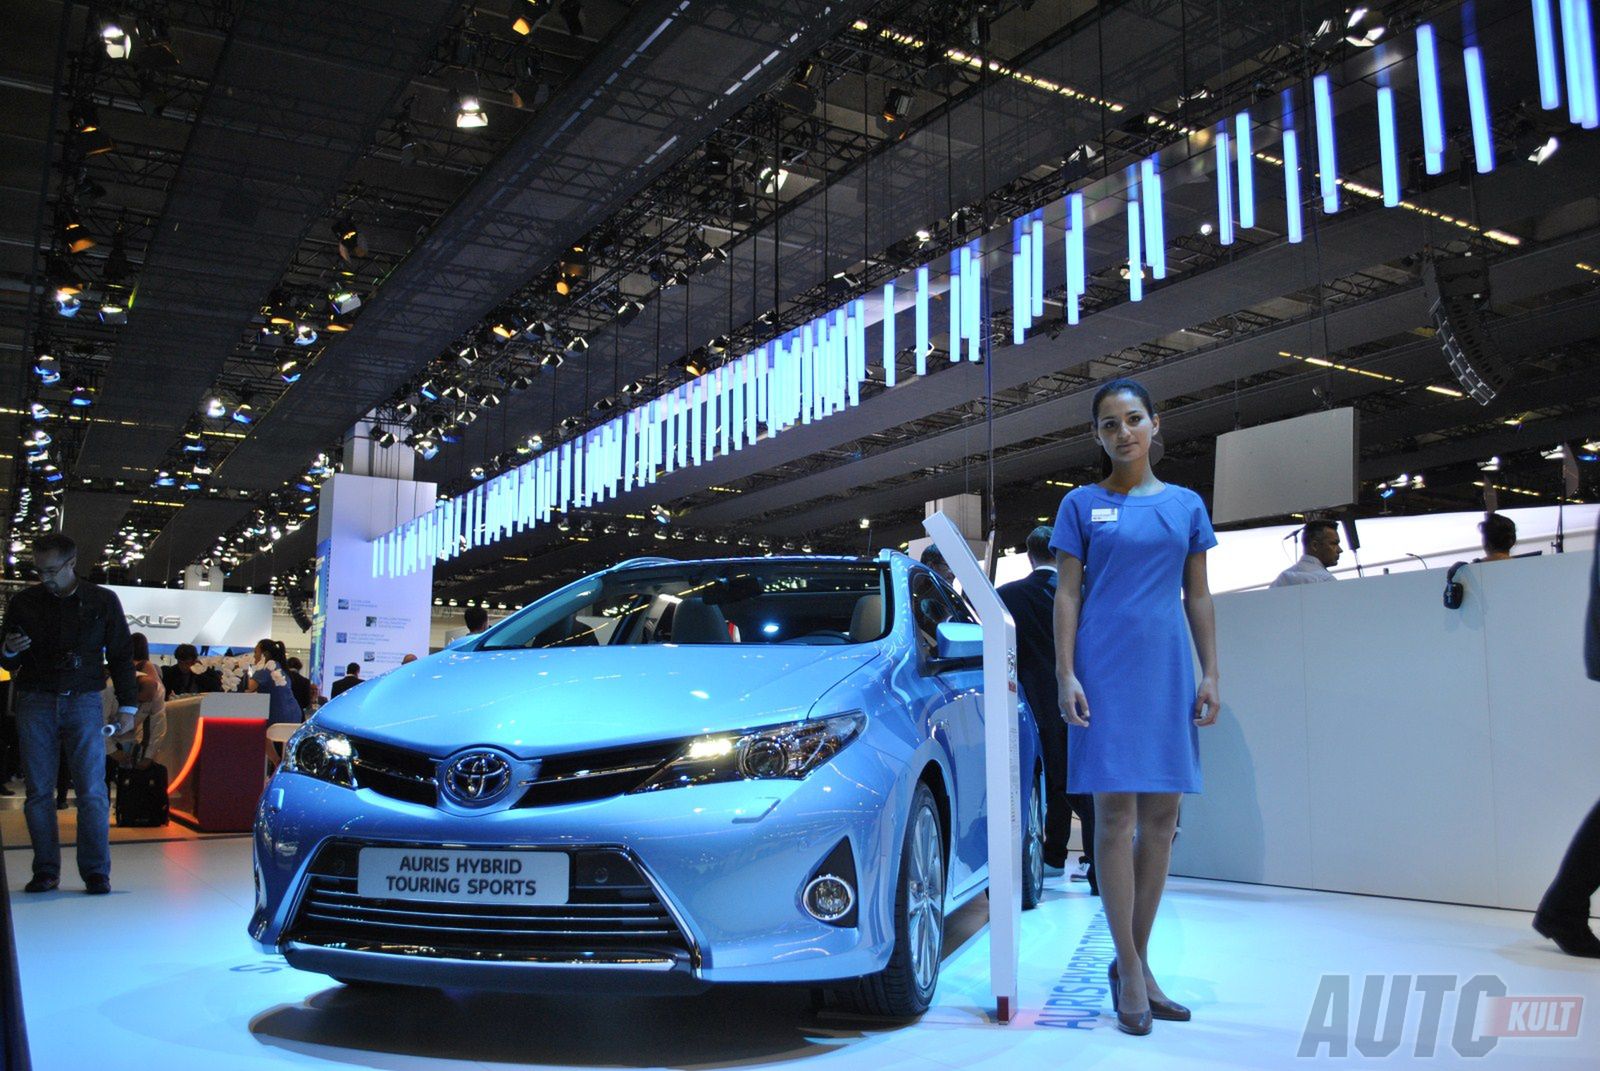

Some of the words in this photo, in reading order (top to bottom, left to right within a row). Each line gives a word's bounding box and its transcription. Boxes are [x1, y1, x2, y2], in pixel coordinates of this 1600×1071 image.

[125, 614, 181, 629] XUS
[399, 856, 450, 873] AURIS
[456, 858, 523, 875] HYBRID
[386, 875, 460, 894] TOURING
[467, 879, 537, 896] SPORTS
[1059, 946, 1116, 985] HYBRID
[1034, 985, 1108, 1030] AURIS
